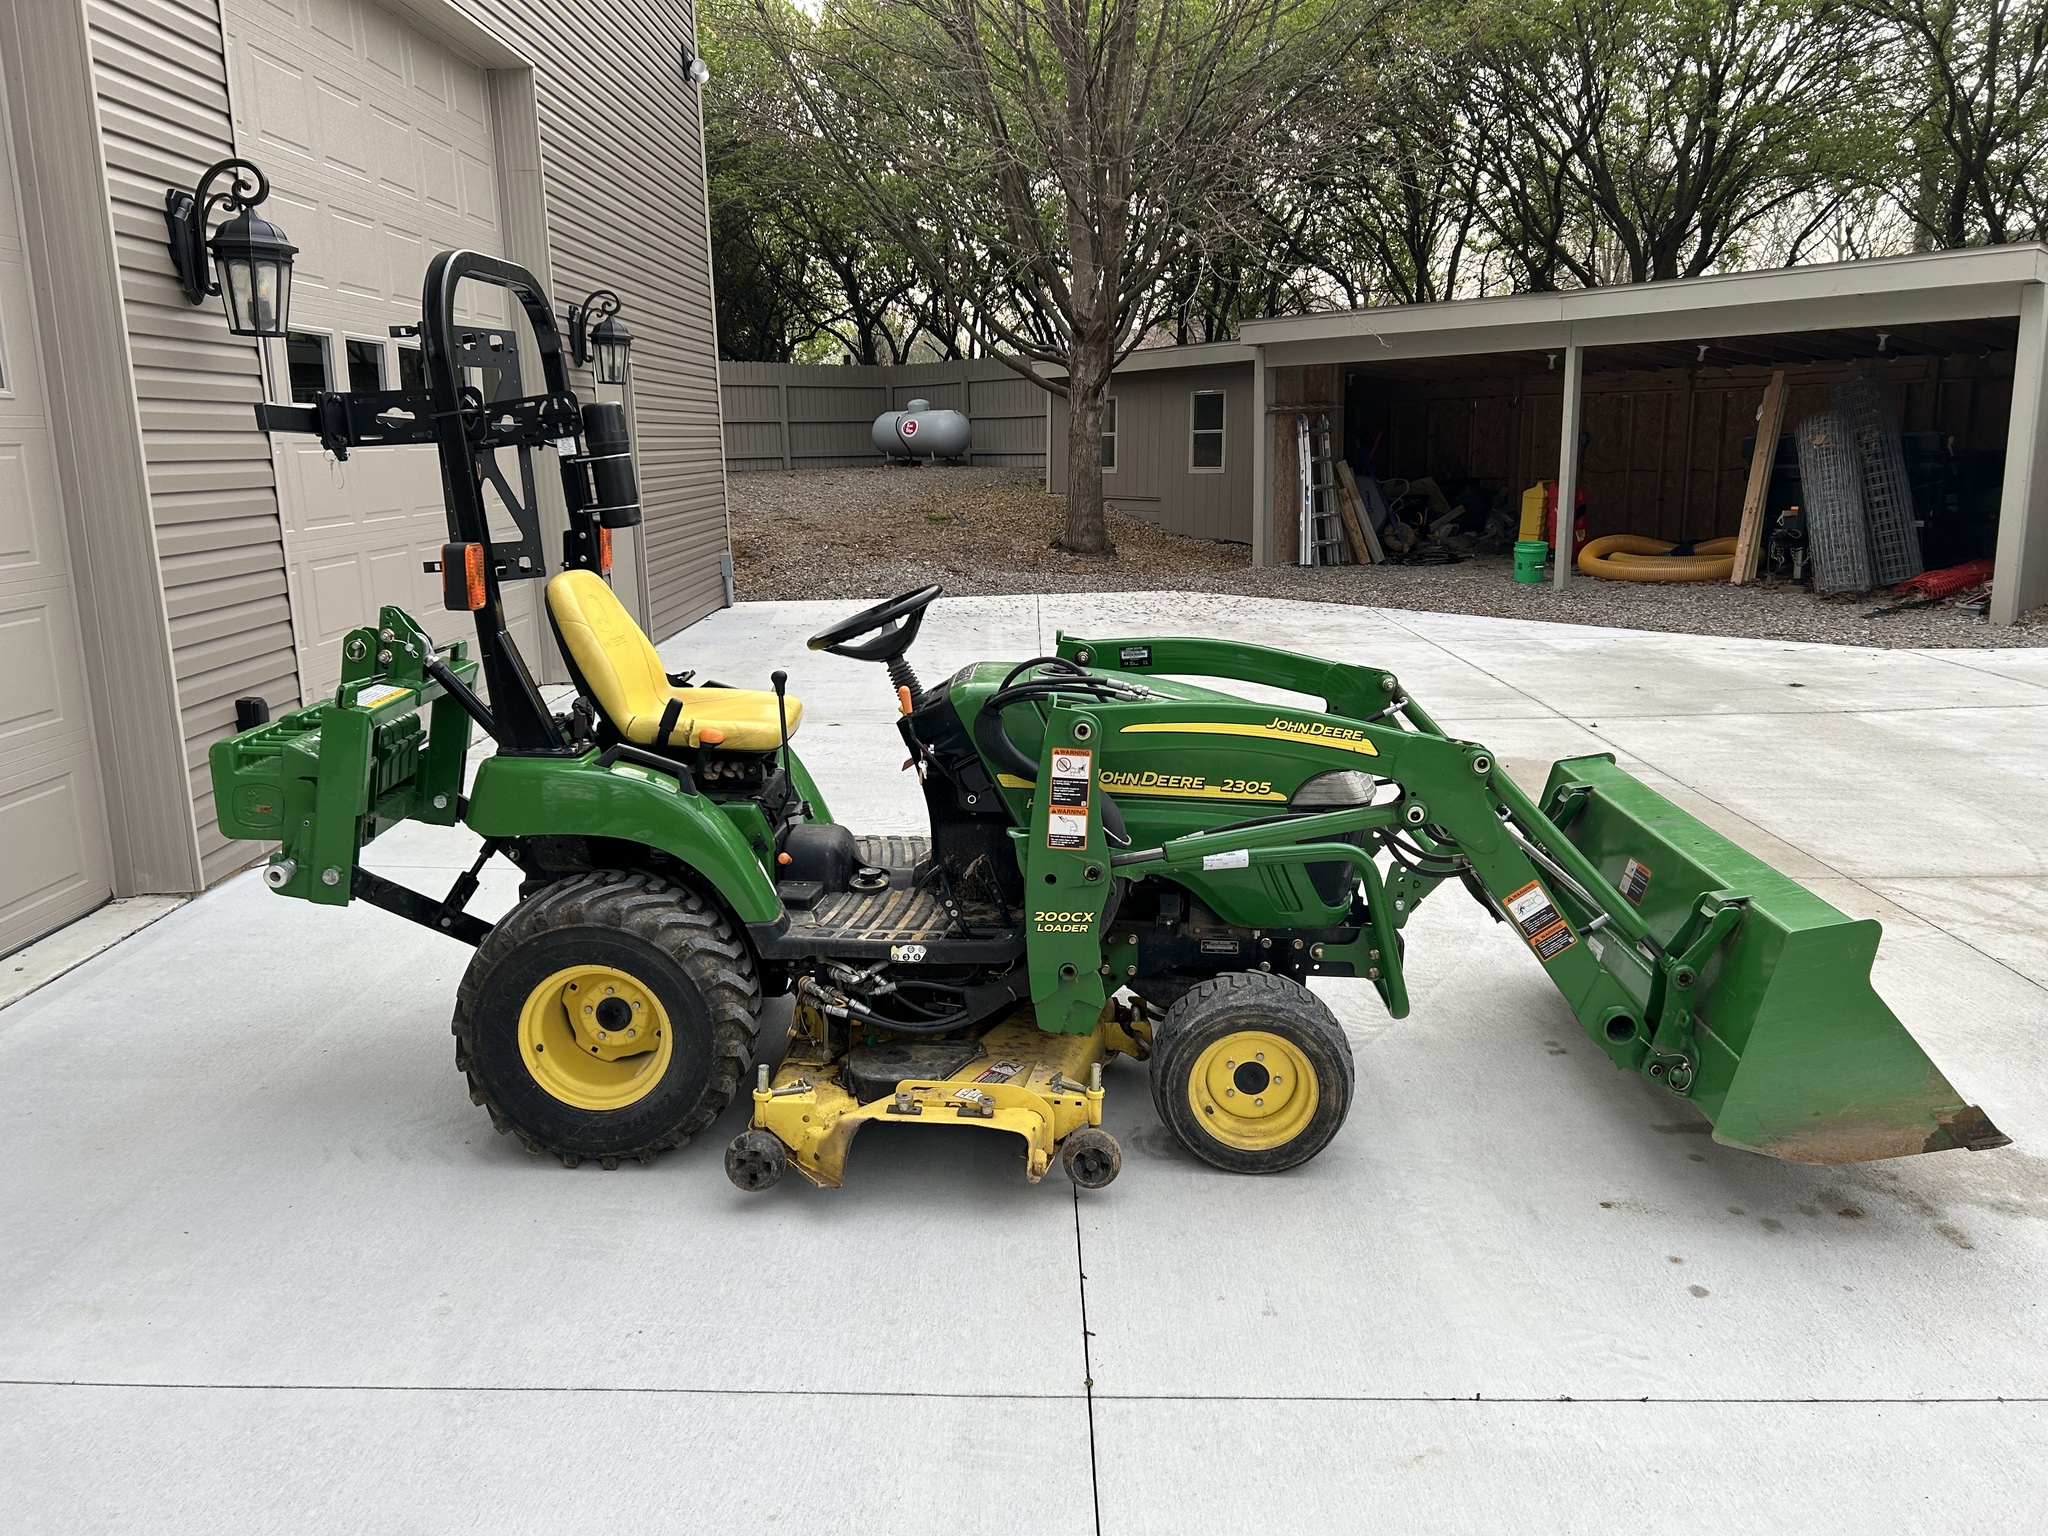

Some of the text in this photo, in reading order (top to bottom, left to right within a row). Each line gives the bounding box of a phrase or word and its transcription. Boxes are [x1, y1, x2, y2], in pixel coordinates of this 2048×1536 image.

[1266, 717, 1365, 741] JOHN DEERE
[1140, 771, 1206, 789] DEERE
[1220, 779, 1272, 795] 2305
[1512, 883, 1536, 899] WARNING
[1033, 911, 1096, 923] 200CX
[1036, 923, 1089, 933] LOADER
[1540, 923, 1564, 939] WARNING
